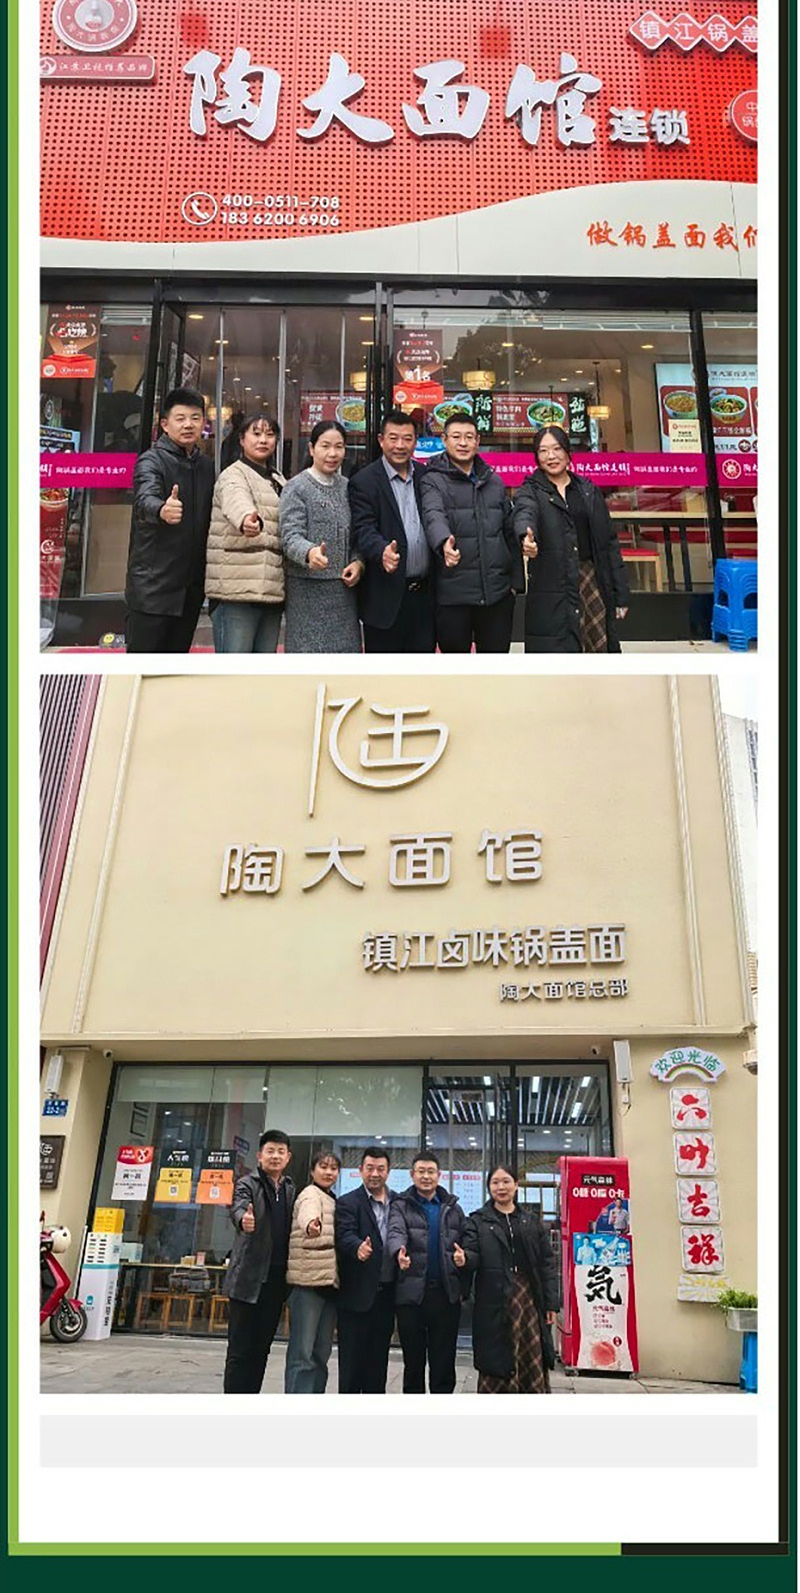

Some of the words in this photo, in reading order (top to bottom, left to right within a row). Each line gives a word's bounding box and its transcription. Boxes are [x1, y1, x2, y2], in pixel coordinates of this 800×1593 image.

[183, 47, 603, 147] 陶大面馆
[608, 107, 691, 146] 连锁
[221, 212, 248, 226] 183
[253, 212, 295, 226] 6200
[299, 212, 340, 226] 6906
[219, 828, 545, 897] 陶大面馆
[361, 923, 626, 972] 镇江卤味锅盖面
[500, 978, 629, 1003] 陶大面馆总部
[655, 1050, 721, 1074] 欢迎光临
